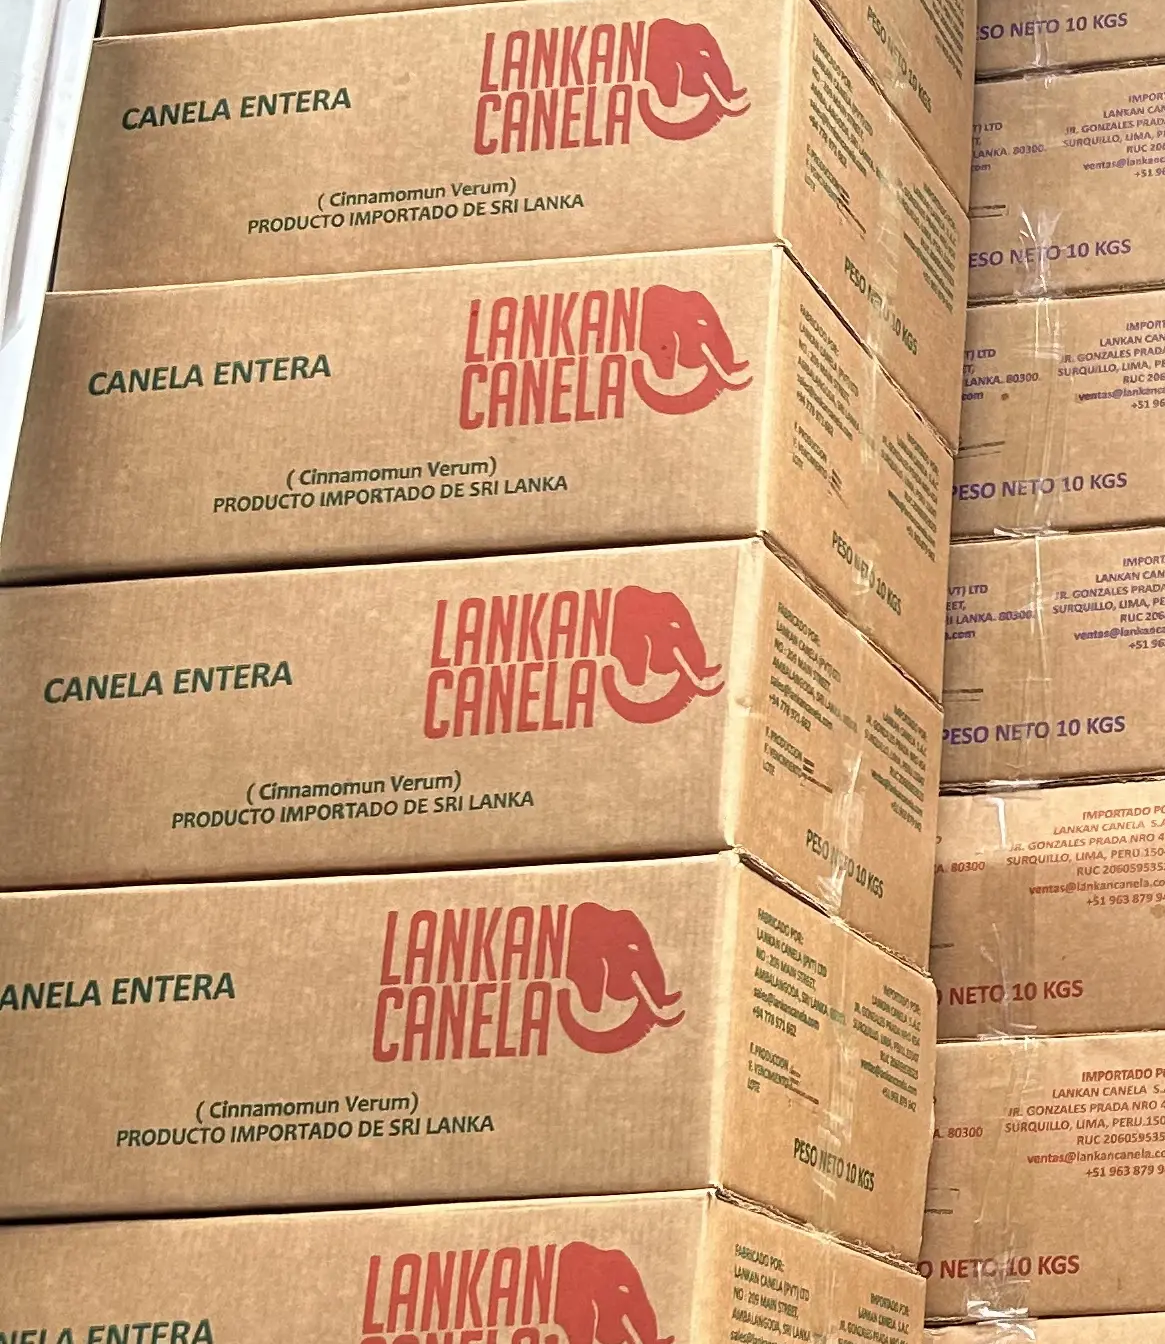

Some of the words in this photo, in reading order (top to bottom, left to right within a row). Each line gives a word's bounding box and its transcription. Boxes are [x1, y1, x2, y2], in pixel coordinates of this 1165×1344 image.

[481, 21, 645, 94] LANKAN
[121, 97, 231, 131] CANELA
[239, 86, 352, 120] ENTERA
[474, 84, 633, 156] CANELA
[247, 212, 345, 235] PRODUCTO
[349, 203, 459, 227] IMPORTADO
[462, 201, 487, 218] DE
[489, 197, 519, 216] SRI
[523, 193, 585, 214] LANKA
[465, 288, 639, 364] LANKAN
[88, 363, 204, 397] CANELA
[213, 353, 332, 387] ENTERA
[460, 354, 627, 430] CANELA
[432, 588, 612, 669] LANKAN
[43, 669, 164, 705] CANELA
[172, 659, 293, 696] ENTERA
[425, 660, 597, 740] CANELA
[171, 806, 276, 830] PRODUCTO
[279, 799, 399, 824] IMPORTADO
[403, 797, 429, 816] DE
[433, 795, 463, 814] SRI
[468, 790, 534, 812] LANKA
[382, 902, 568, 987] LANKAN
[0, 978, 102, 1012] ANELA
[111, 971, 236, 1006] ENTERA
[373, 981, 552, 1062] CANELA
[363, 1244, 556, 1336] LANKAN
